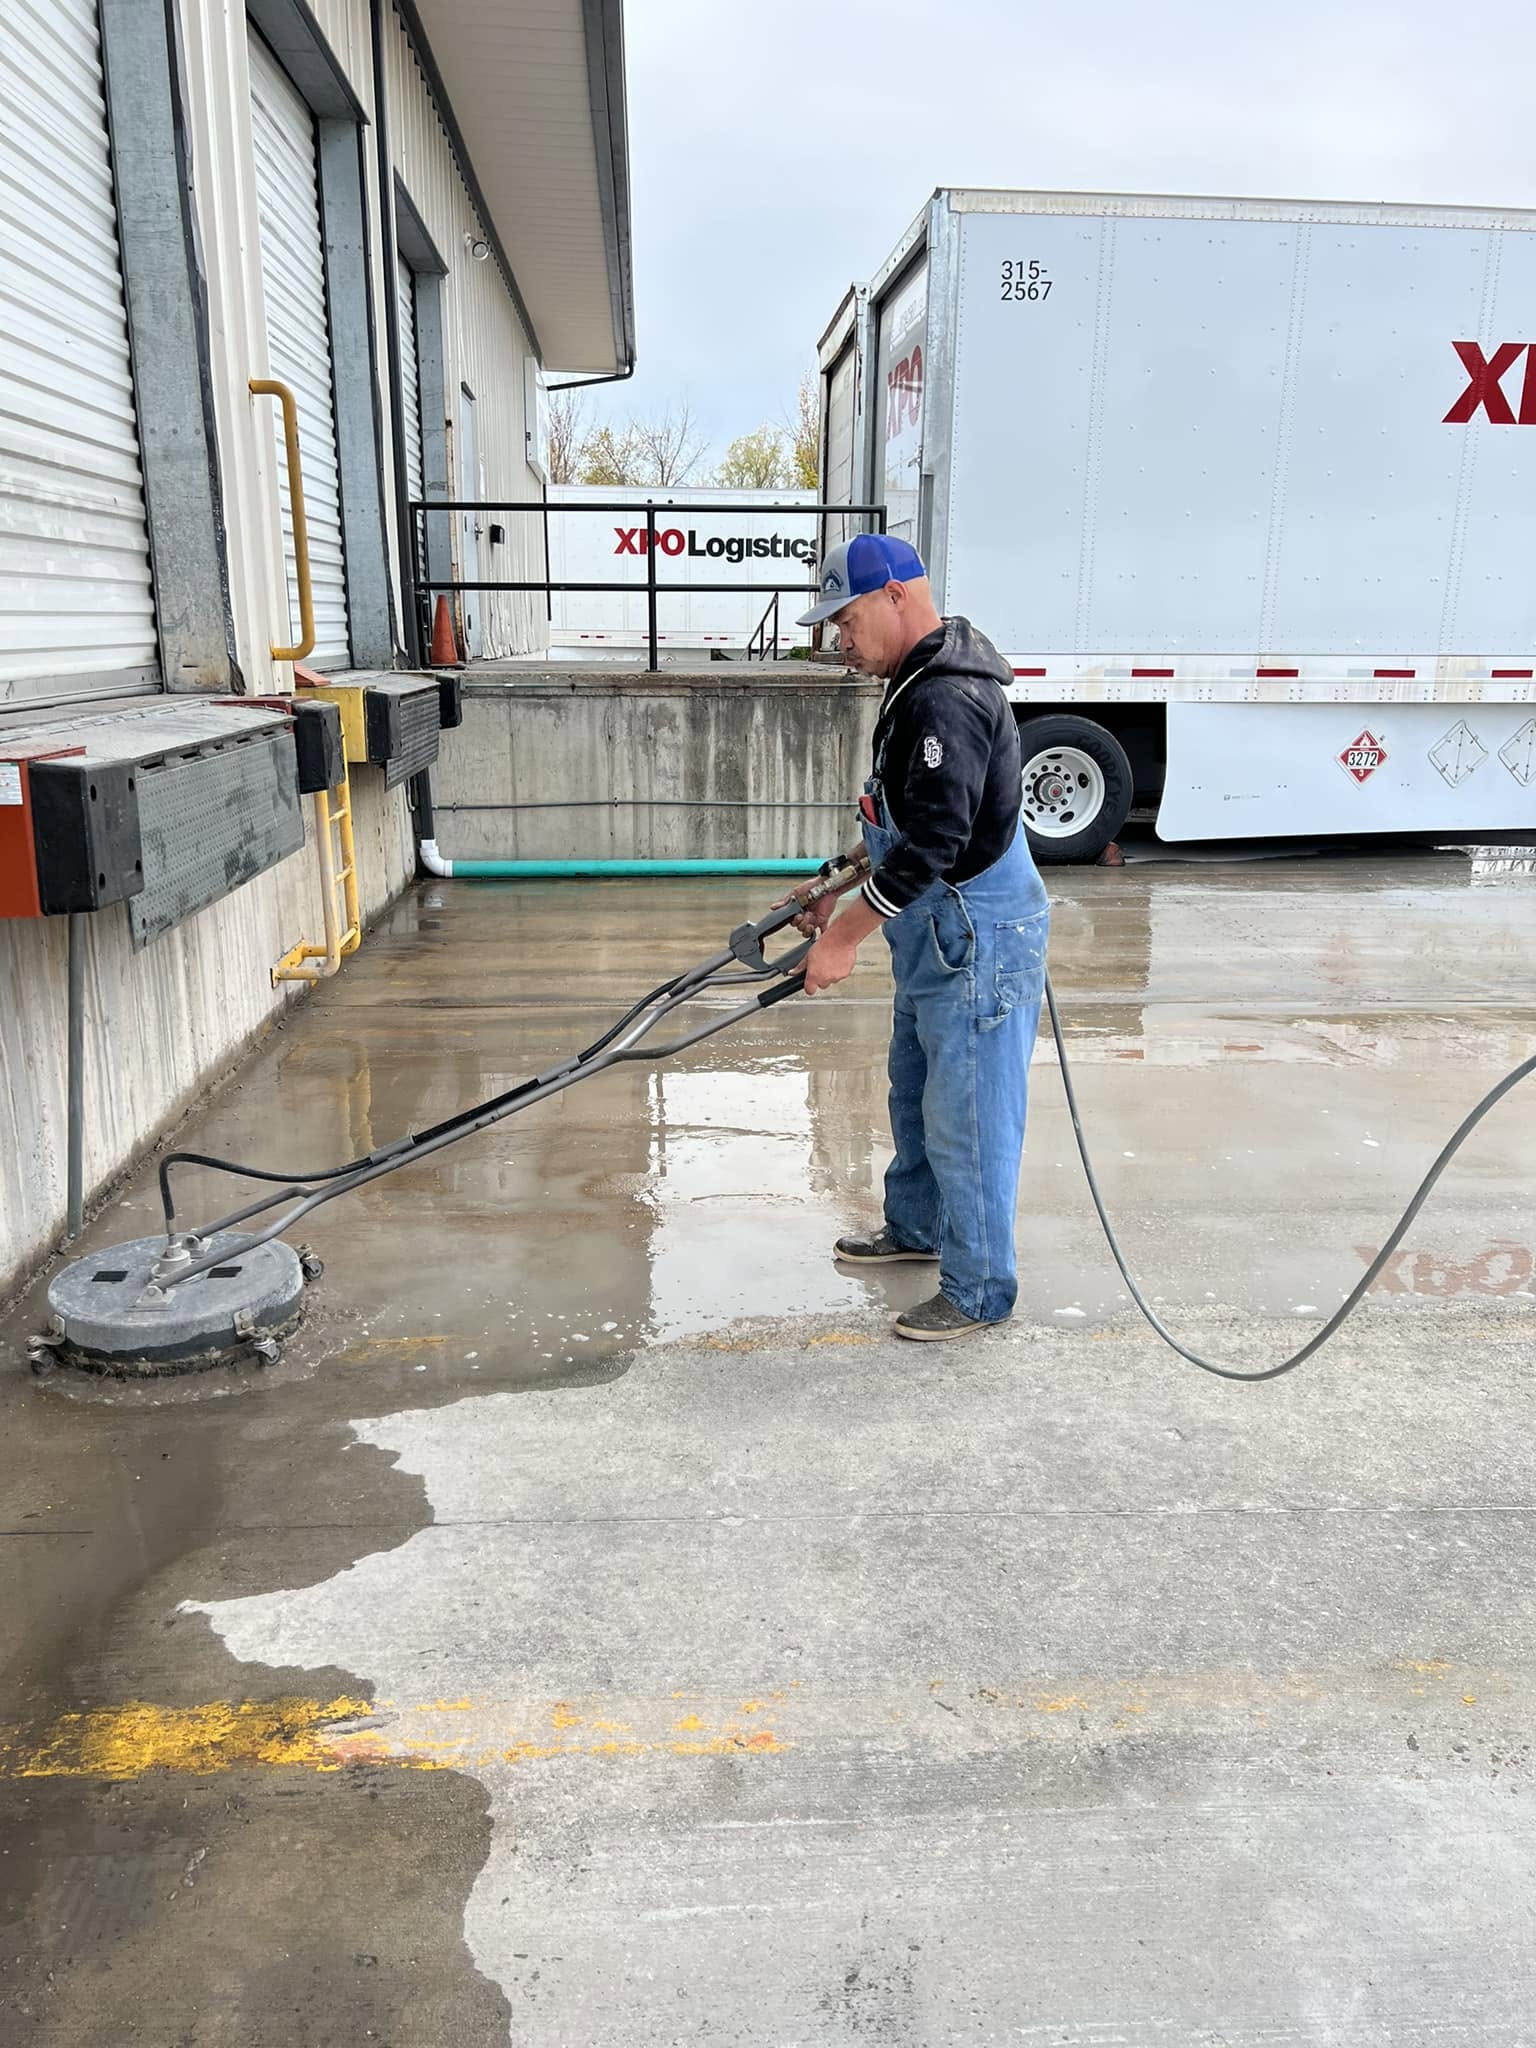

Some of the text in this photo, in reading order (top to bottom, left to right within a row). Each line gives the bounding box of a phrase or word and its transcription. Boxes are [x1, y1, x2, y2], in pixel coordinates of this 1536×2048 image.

[1001, 260, 1048, 280] 315-
[1001, 281, 1053, 301] 2567
[886, 344, 923, 442] XPO
[613, 528, 685, 556] XPO
[1348, 751, 1378, 767] 3272
[1358, 769, 1365, 778] 3
